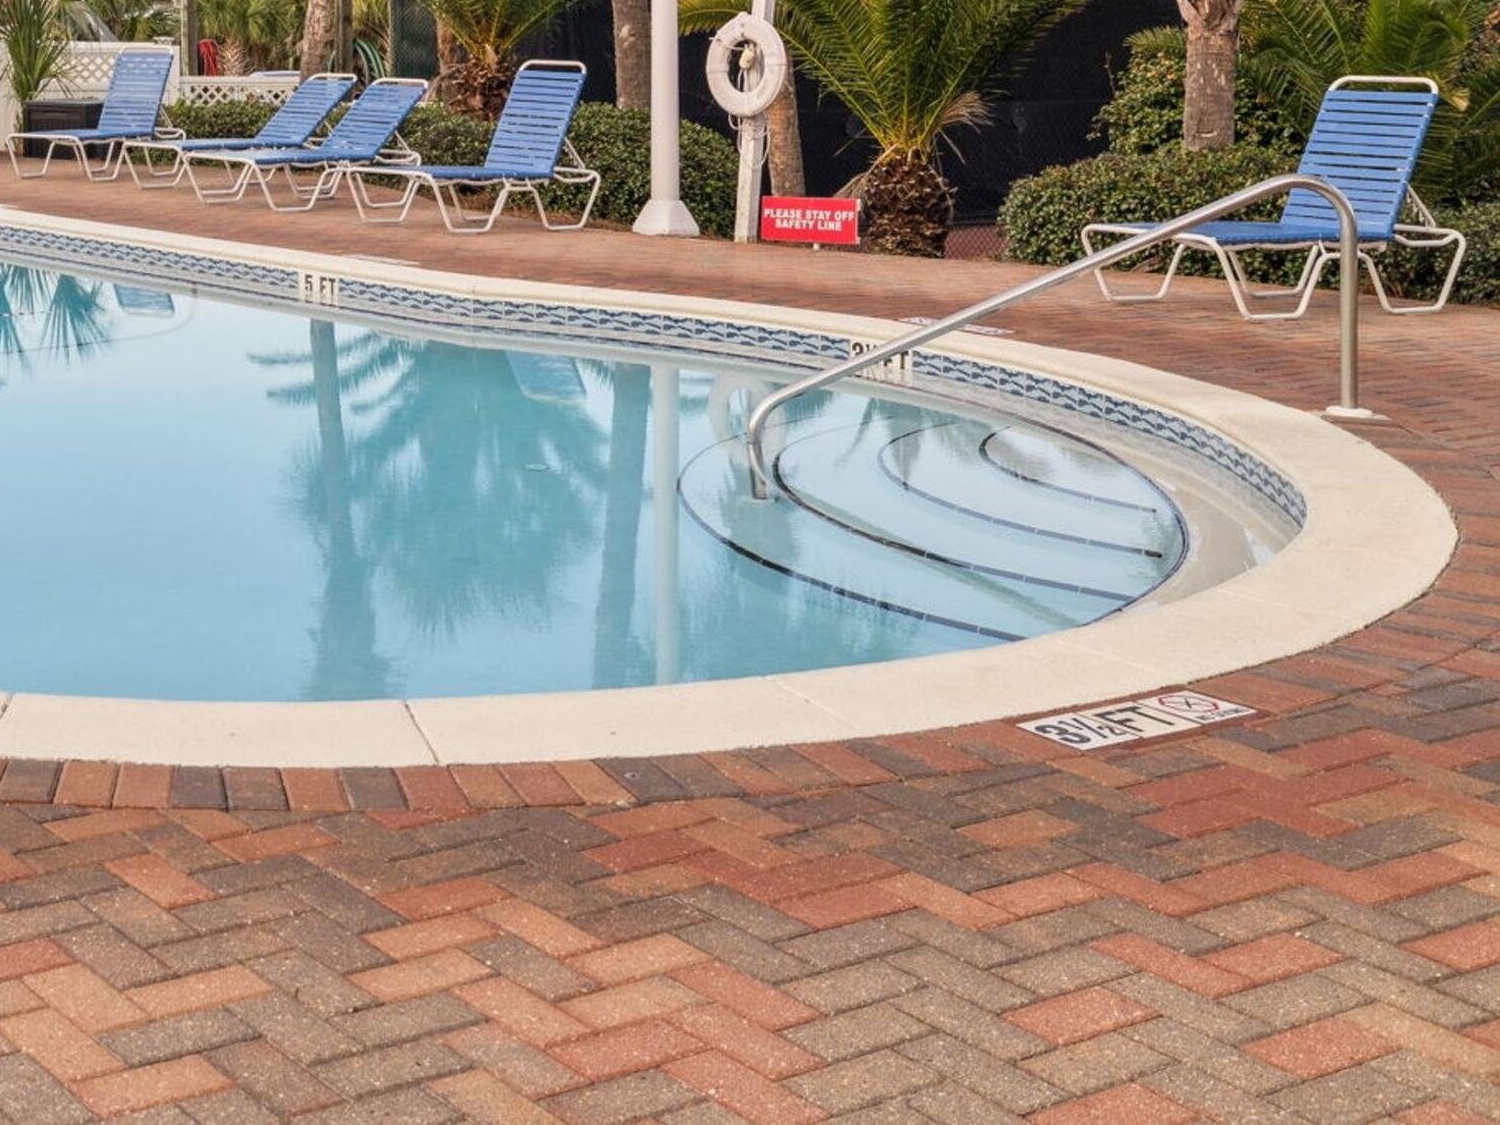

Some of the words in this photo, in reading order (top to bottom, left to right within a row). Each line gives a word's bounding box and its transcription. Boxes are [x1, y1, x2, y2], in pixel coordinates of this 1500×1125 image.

[764, 208, 801, 219] PLEASE
[805, 210, 831, 220] STAY
[835, 210, 855, 221] OFF
[775, 219, 814, 229] SAFETY
[817, 220, 842, 231] LINE
[304, 274, 313, 292] 5
[320, 276, 336, 296] FT
[1094, 706, 1175, 733] FT
